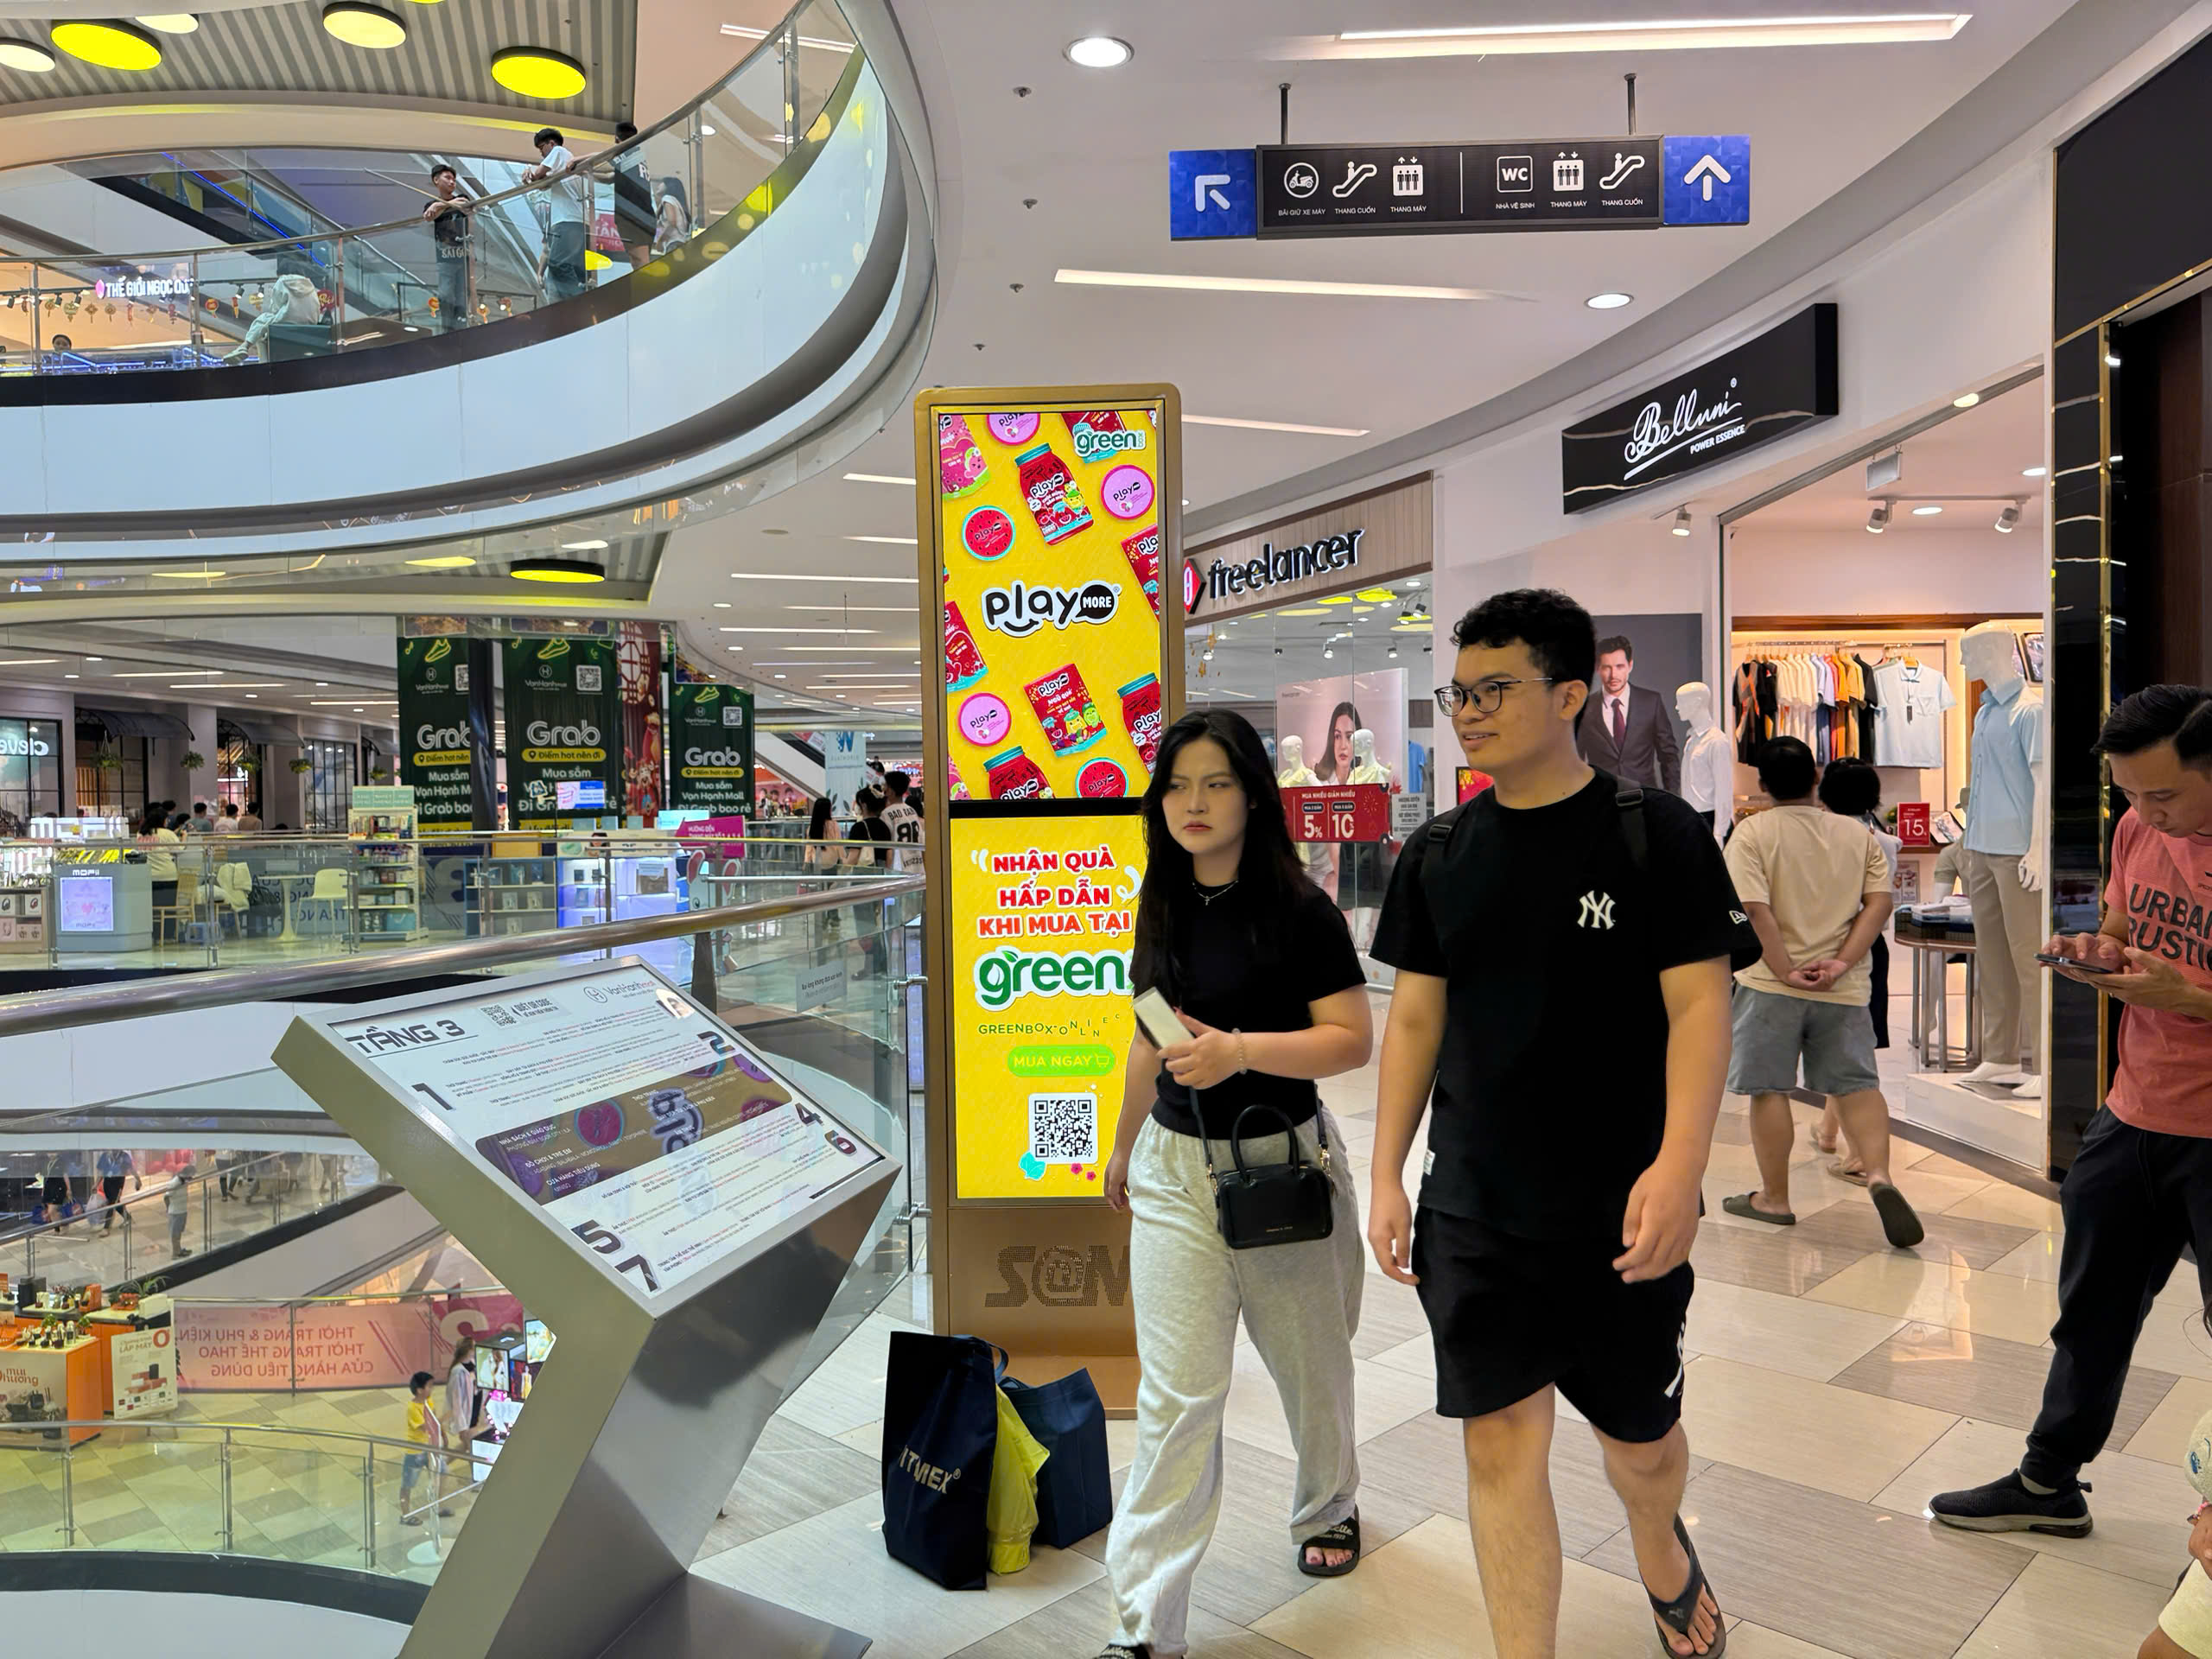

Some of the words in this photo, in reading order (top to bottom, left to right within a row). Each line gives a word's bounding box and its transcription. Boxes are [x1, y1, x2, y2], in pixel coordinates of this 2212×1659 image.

[1502, 168, 1528, 181] WC
[1076, 432, 1137, 454] green
[1690, 437, 1714, 454] POWER
[1715, 423, 1745, 445] ESSENCE
[1031, 479, 1054, 498] play
[1113, 485, 1134, 501] play
[975, 524, 994, 541] play
[1207, 527, 1365, 601] freelancer
[985, 584, 1079, 630] play
[1083, 596, 1112, 608] MORE
[1039, 678, 1060, 696] play
[970, 714, 989, 728] play
[1135, 711, 1160, 730] play
[417, 721, 471, 750] Grab
[527, 720, 601, 747] Grab
[561, 750, 576, 760] hot
[685, 747, 741, 766] Grab
[429, 771, 449, 782] Mua
[542, 767, 567, 779] Mua
[568, 766, 592, 778] sắm
[415, 787, 432, 798] Vạn
[434, 785, 459, 798] Hạnh
[695, 781, 715, 790] Mua
[682, 792, 699, 801] Vạn
[700, 792, 724, 802] Hạnh
[423, 802, 453, 816] Grab
[718, 804, 741, 814] bao
[994, 849, 1058, 877] NHẬN
[1064, 845, 1116, 870] QUÀ
[1000, 879, 1051, 907] HẤP
[1058, 877, 1110, 906] DẪN
[1577, 890, 1616, 930] NY
[979, 915, 1020, 938] KHI
[1029, 912, 1082, 935] MUA
[1091, 912, 1131, 937] TẠI
[979, 950, 1125, 1007] green
[346, 1024, 441, 1053] TẦNG
[436, 1019, 466, 1036] 3
[696, 1031, 735, 1057] 2
[1014, 1055, 1046, 1067] MUA
[1051, 1055, 1092, 1067] NGAY
[411, 1082, 455, 1112] 1
[794, 1103, 823, 1126] 4
[824, 1130, 857, 1155] 6
[571, 1219, 623, 1255] 5
[614, 1254, 658, 1292] 7
